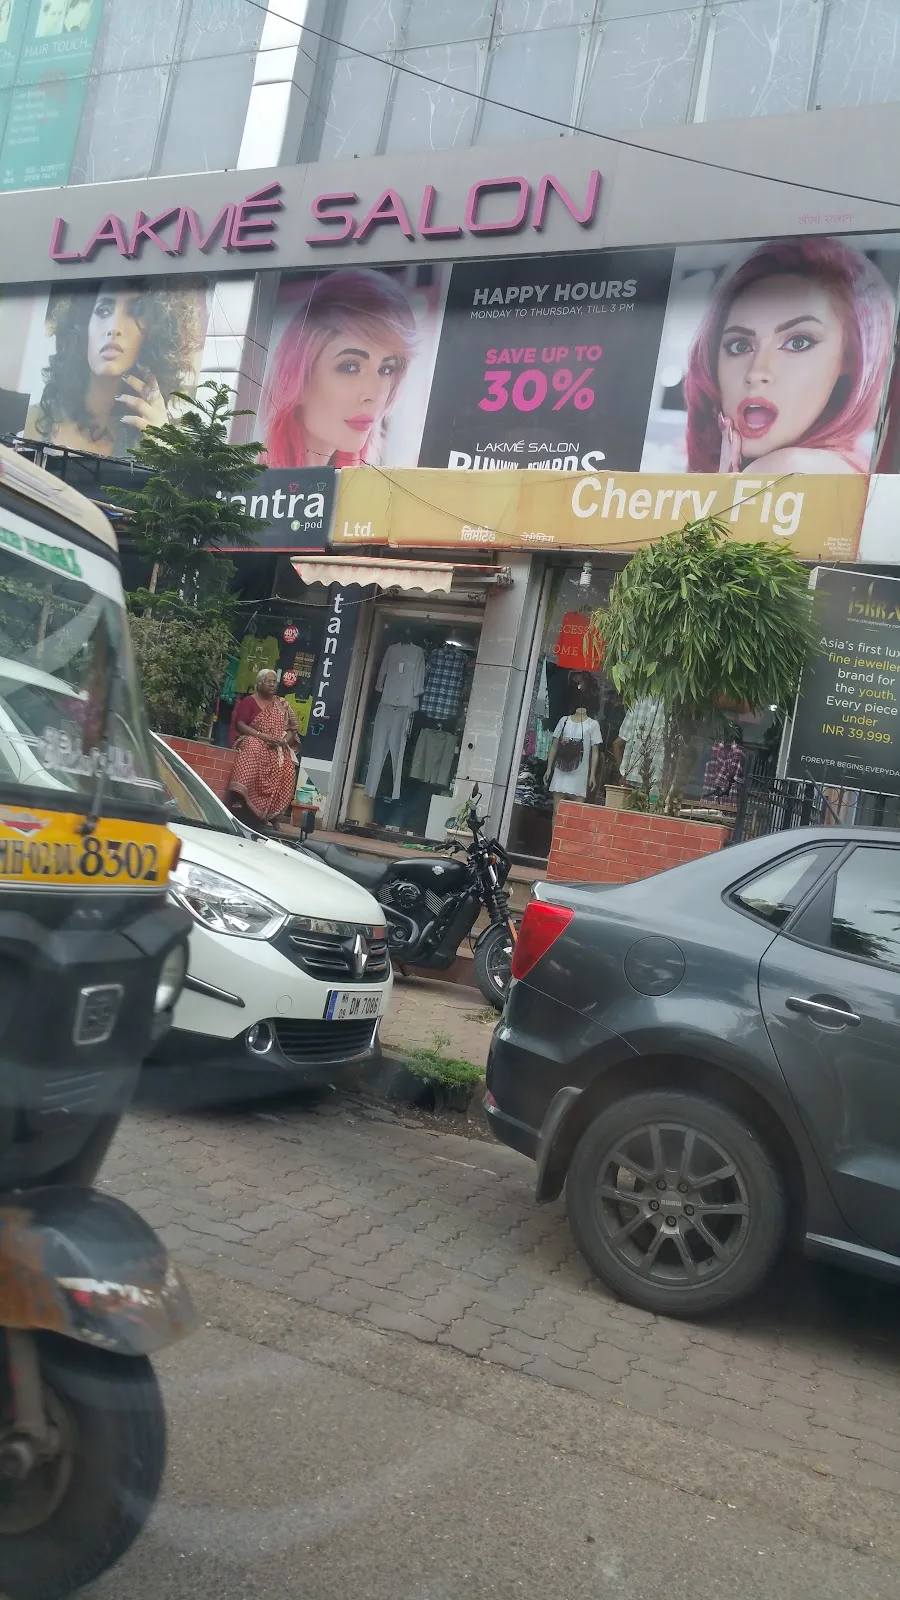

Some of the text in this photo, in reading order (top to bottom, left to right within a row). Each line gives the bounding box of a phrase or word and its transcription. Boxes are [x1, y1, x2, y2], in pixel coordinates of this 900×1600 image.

[49, 169, 602, 264] LAKMÉ SALON
[472, 279, 637, 306] HAPPY HOURS
[470, 302, 635, 320] MONDAY TO THURSDAY, TILL 3 PM
[485, 345, 602, 365] SAVE UP TO
[477, 367, 595, 412] 30%
[476, 440, 580, 453] LAKMÉ SALON
[571, 477, 805, 536] Cherry Fig
[343, 520, 375, 538] Ltd.
[542, 643, 579, 657] HOME
[819, 637, 854, 651] Asia's
[858, 642, 882, 655] first
[312, 593, 344, 718] tantra
[828, 652, 851, 665] fine
[837, 668, 896, 685] brand for
[835, 682, 897, 701] the youth.
[826, 695, 898, 716] Every piece
[822, 723, 845, 736] INR
[842, 714, 879, 727] under
[800, 754, 836, 767] FOREVER
[837, 760, 864, 771] BEGINS
[79, 836, 159, 882] 8302
